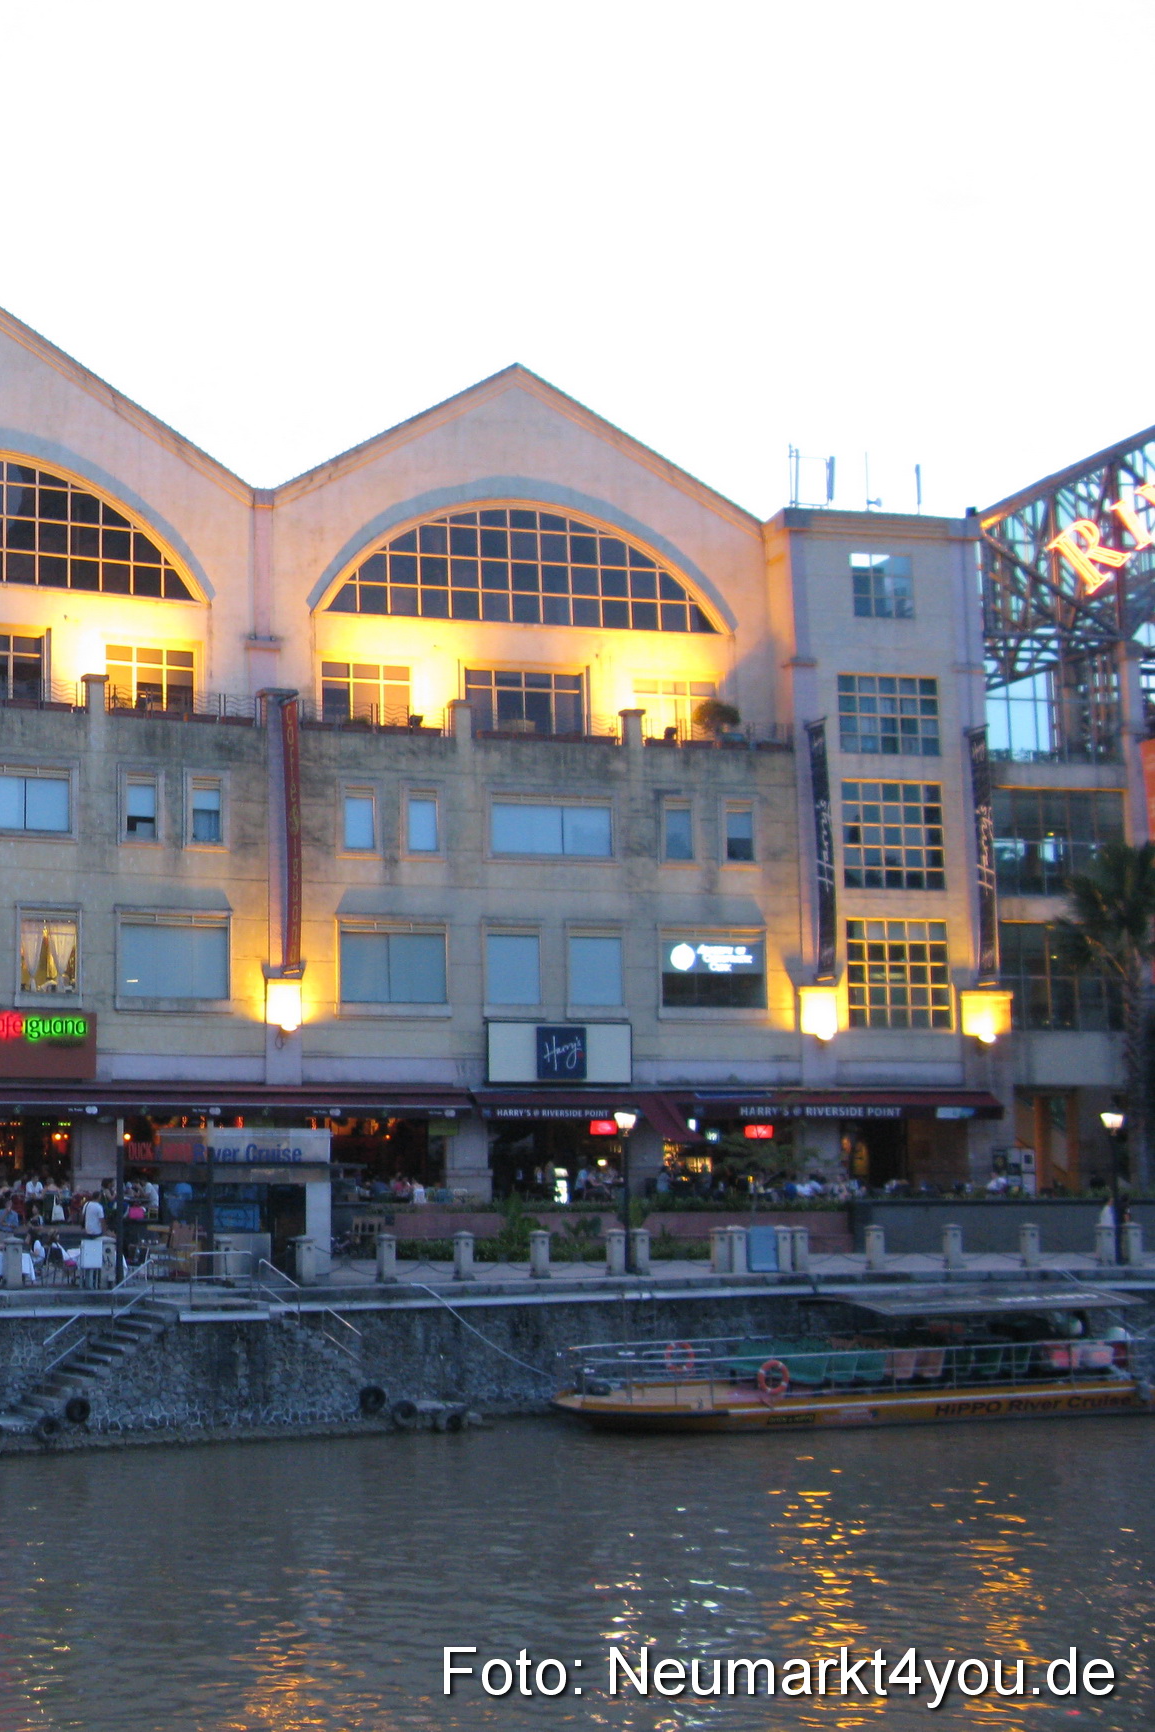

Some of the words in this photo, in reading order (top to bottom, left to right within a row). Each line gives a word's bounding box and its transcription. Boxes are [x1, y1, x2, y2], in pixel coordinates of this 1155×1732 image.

[815, 799, 835, 893] Harry's
[975, 804, 995, 896] Harry's
[543, 1034, 583, 1072] Harry's
[496, 1109, 532, 1118] HARRY'S
[541, 1109, 583, 1118] RIVERSIDE
[584, 1109, 610, 1118] POINT
[739, 1106, 790, 1117] HARRY'S
[804, 1106, 864, 1117] RIVERSIDE
[867, 1107, 903, 1118] POINT
[193, 1142, 240, 1163] Rver
[245, 1142, 302, 1163] Cruise
[1006, 1398, 1062, 1412] River
